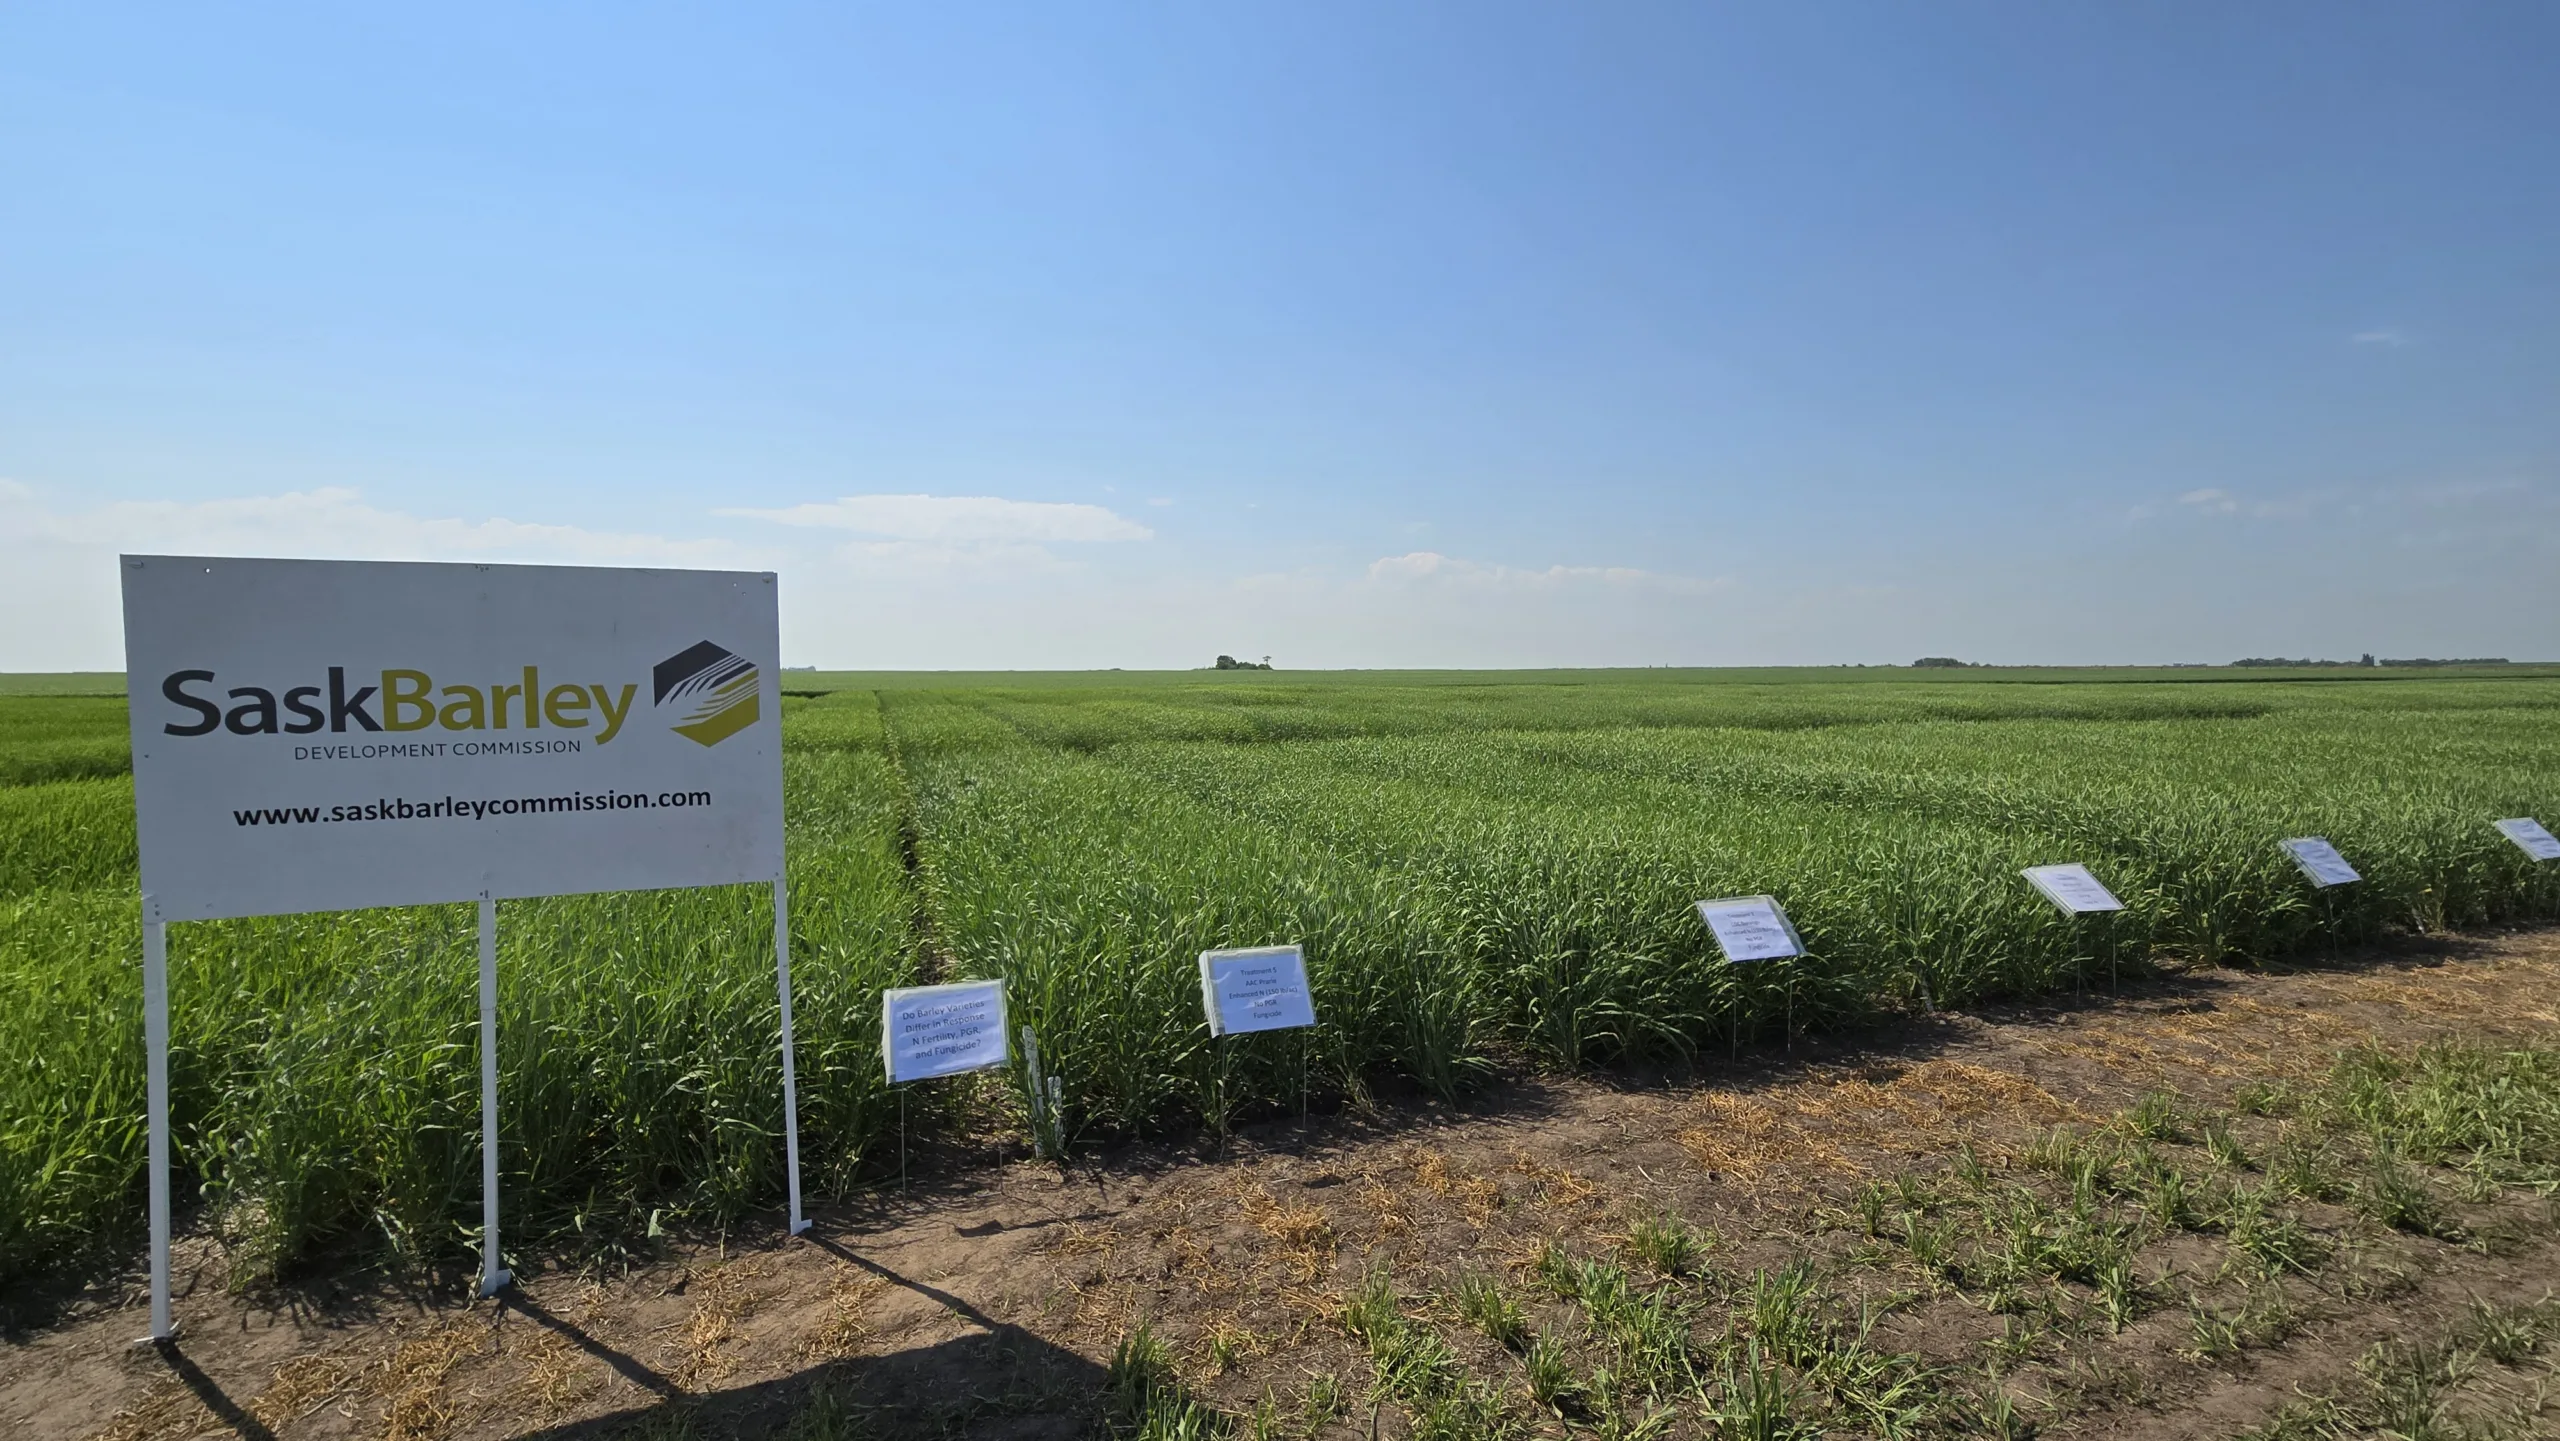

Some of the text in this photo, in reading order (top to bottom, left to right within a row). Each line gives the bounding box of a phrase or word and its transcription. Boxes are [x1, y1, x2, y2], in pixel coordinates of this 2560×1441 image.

[161, 666, 638, 746] SaskBarley
[294, 739, 582, 761] DEVELOPMENT COMMISSION
[232, 788, 712, 828] www.saskbarleycommission.com
[1240, 967, 1272, 976] Treatment
[1245, 979, 1258, 987] AAC
[1229, 990, 1259, 999] Enhanced
[1264, 999, 1277, 1007] PGR
[902, 1001, 985, 1020] Do Barley Varieties
[1253, 1010, 1282, 1019] Fungicide
[905, 1013, 985, 1033] Differ in Response
[912, 1037, 920, 1046] N
[921, 1031, 959, 1044] Fertility,
[915, 1039, 981, 1060] and Fungicide?
